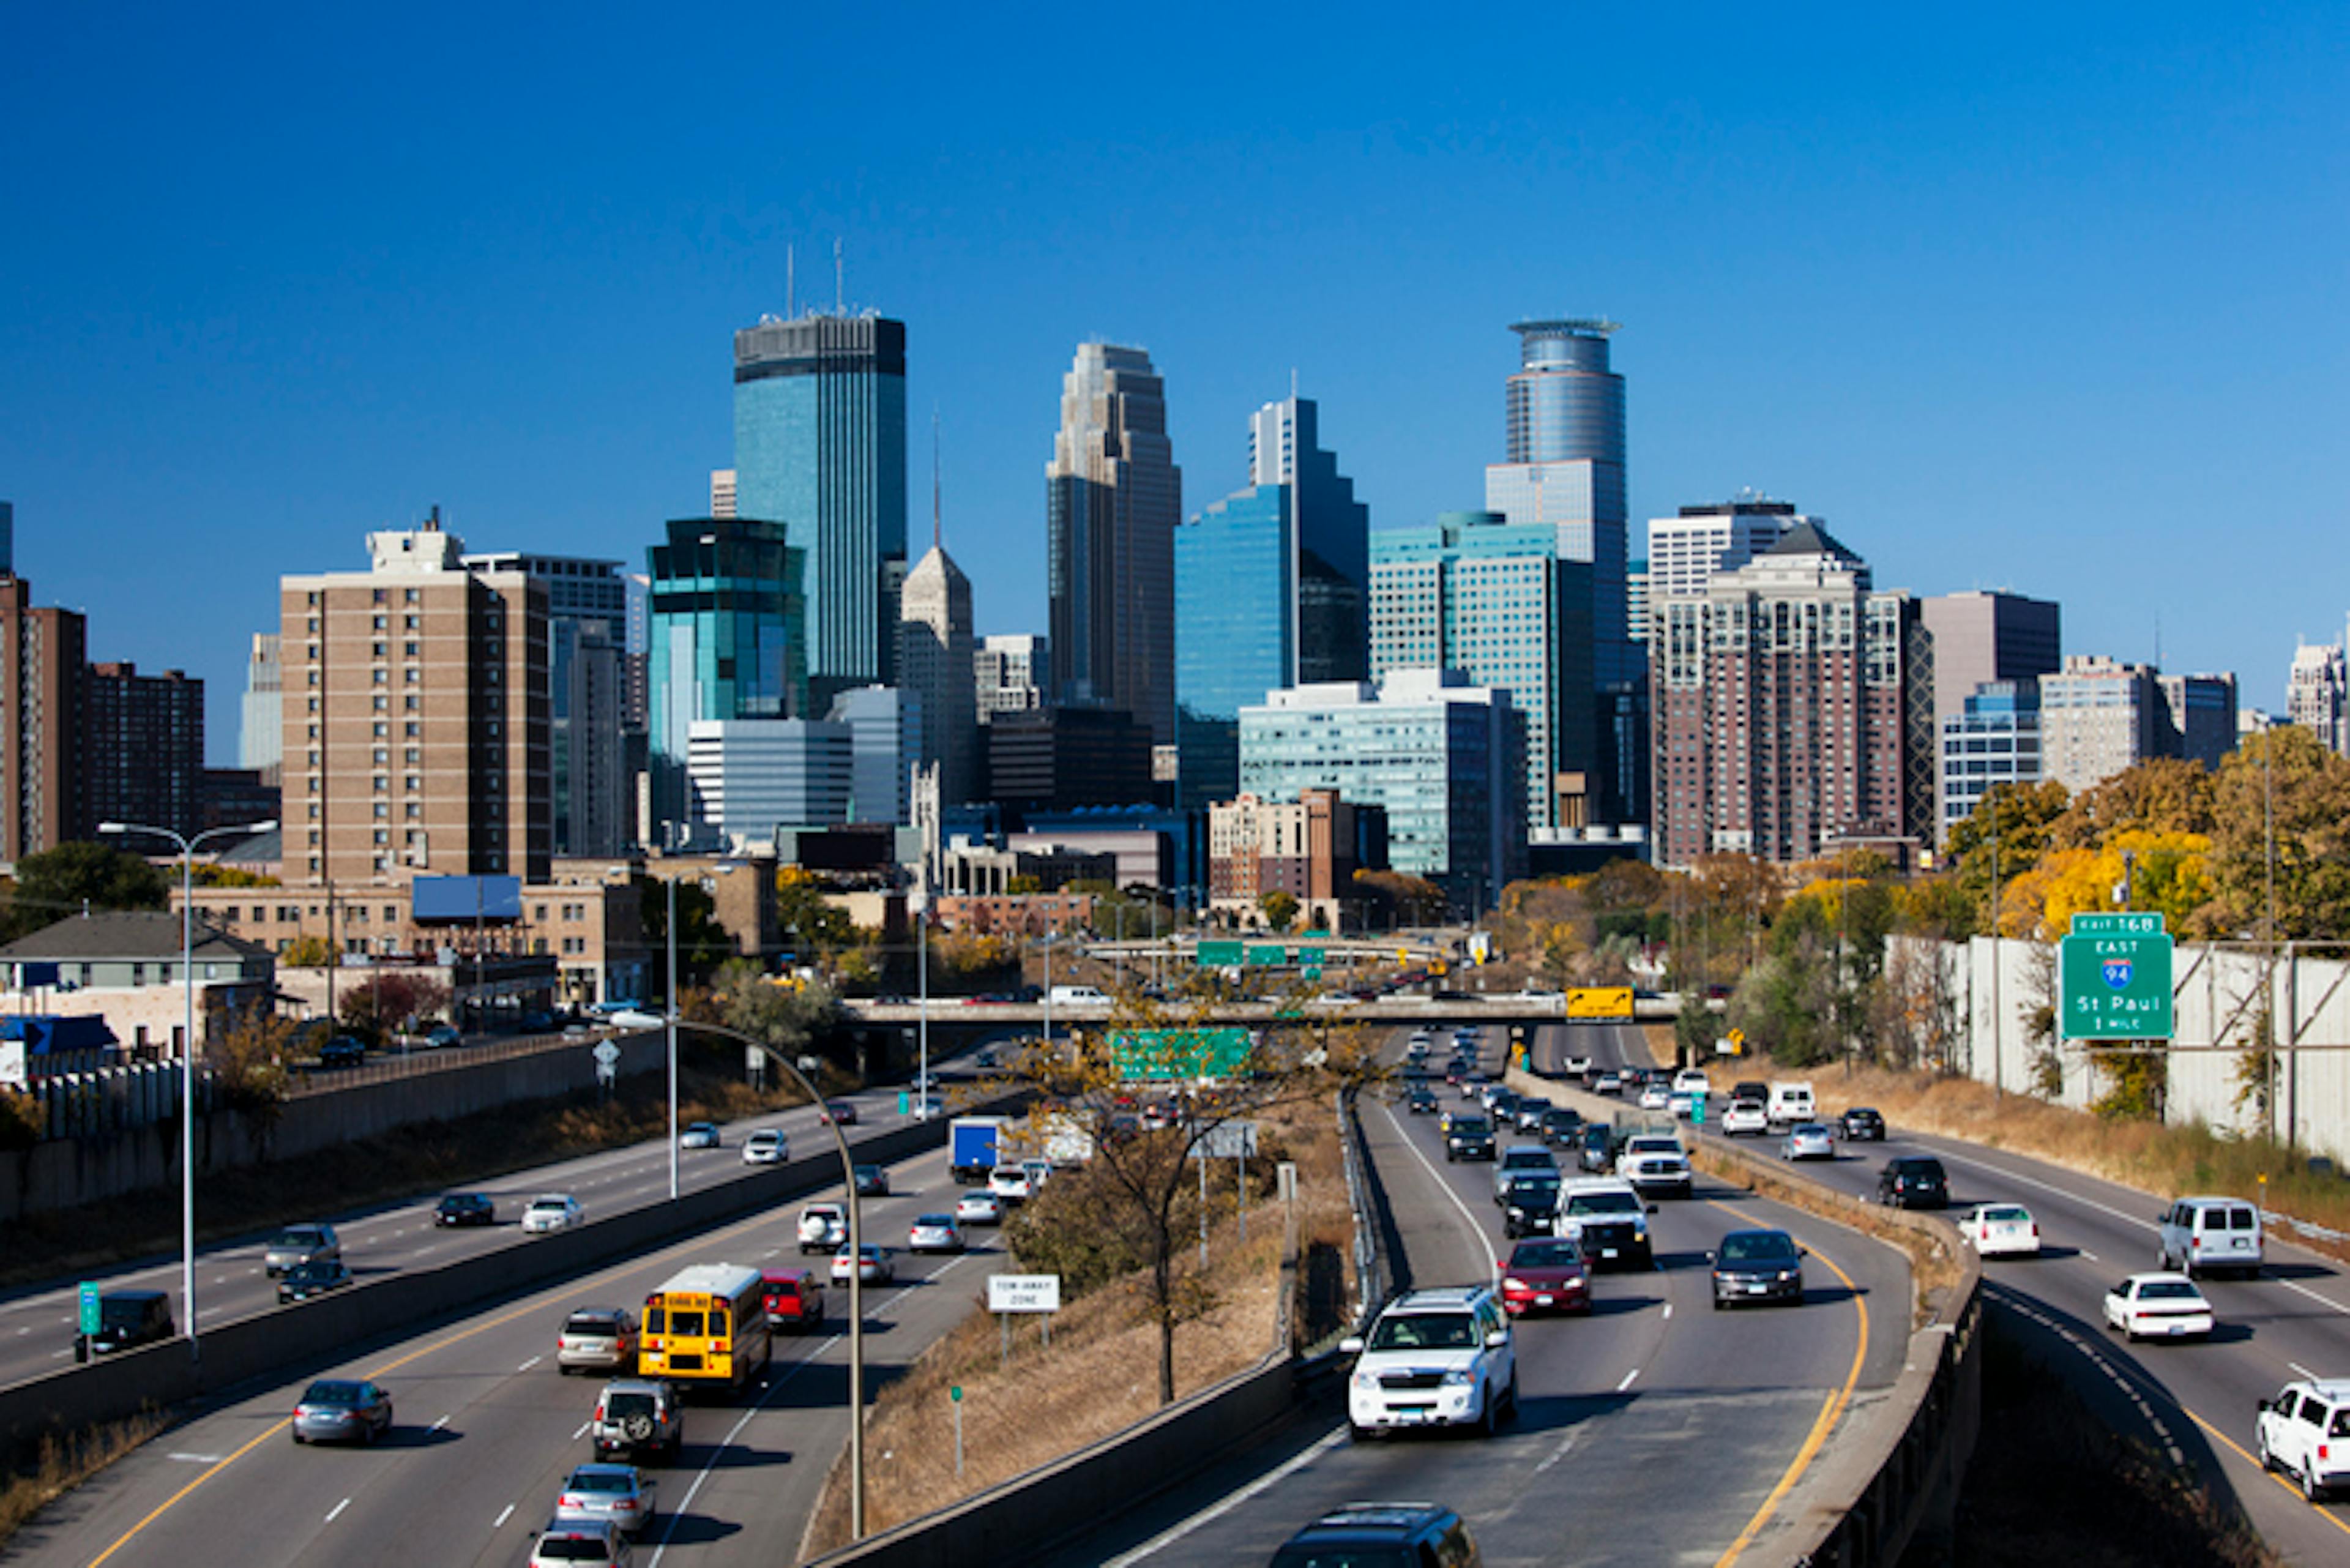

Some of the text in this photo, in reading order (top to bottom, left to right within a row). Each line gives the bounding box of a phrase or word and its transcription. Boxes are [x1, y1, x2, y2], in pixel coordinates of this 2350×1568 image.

[2095, 941, 2138, 953] EAST
[2105, 966, 2128, 981] 94
[2111, 996, 2160, 1010] Paul
